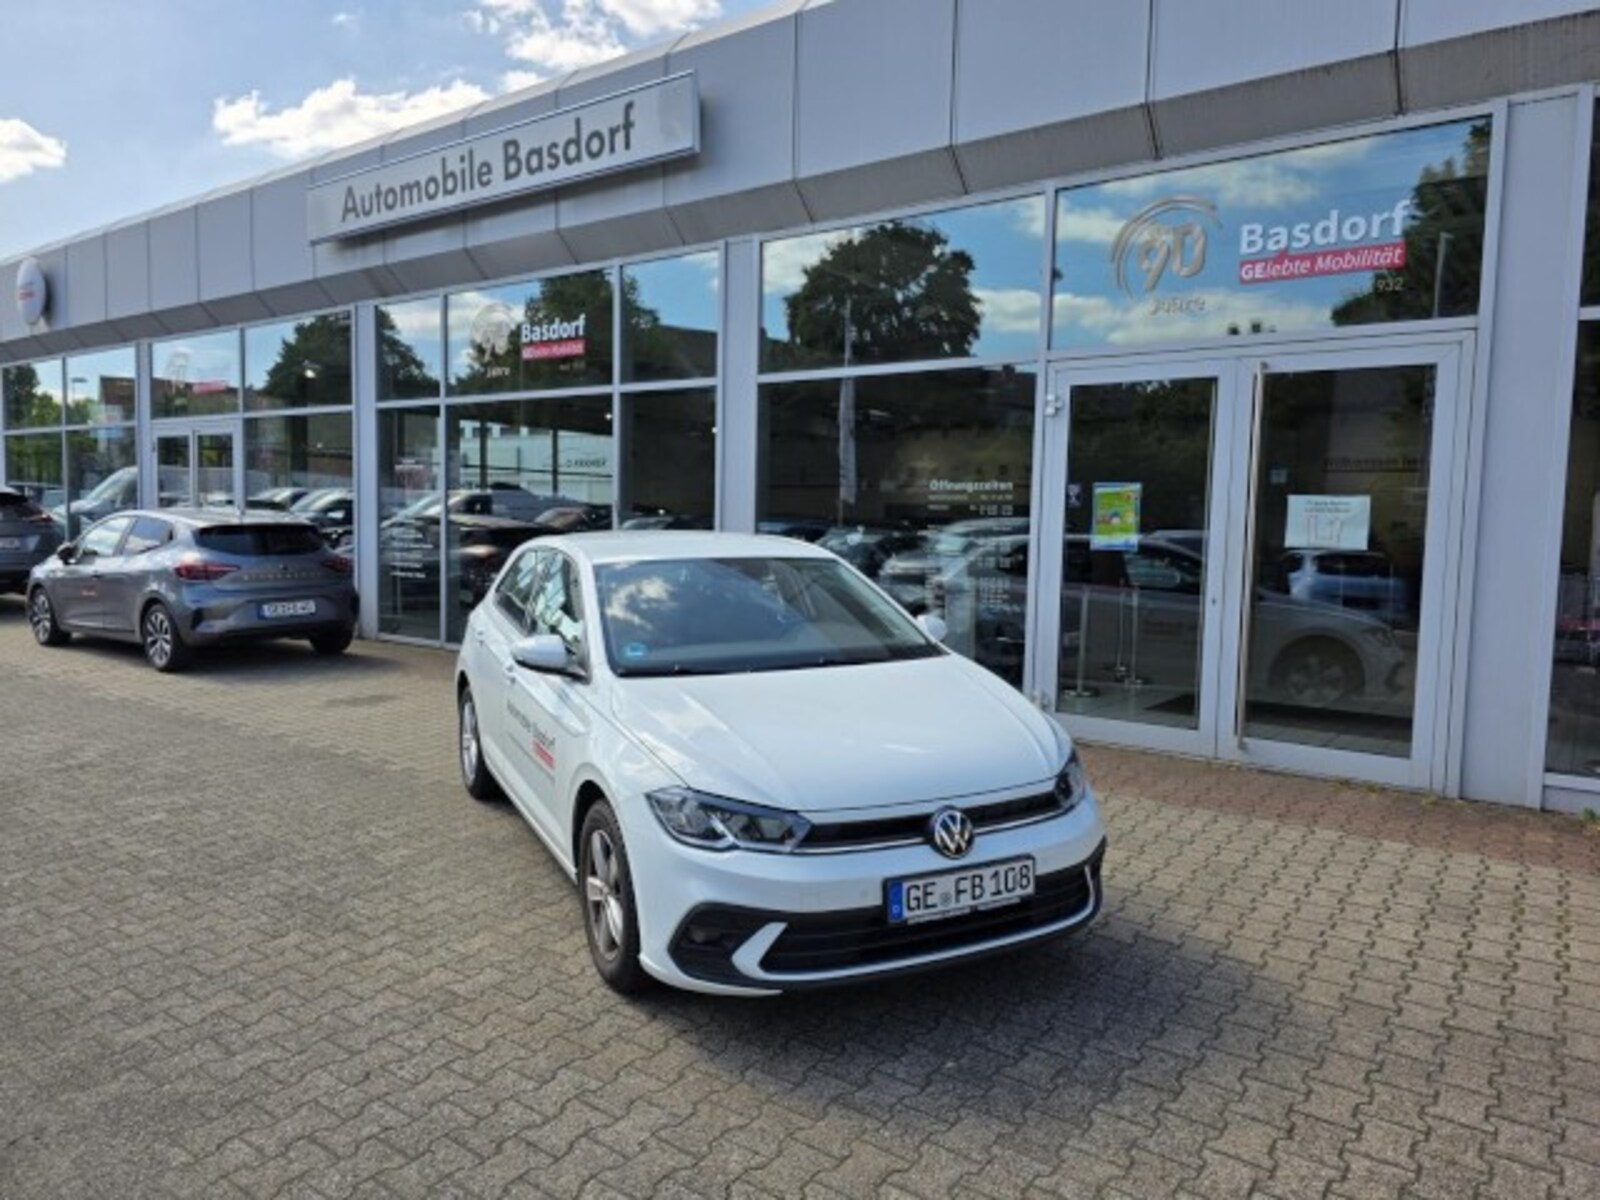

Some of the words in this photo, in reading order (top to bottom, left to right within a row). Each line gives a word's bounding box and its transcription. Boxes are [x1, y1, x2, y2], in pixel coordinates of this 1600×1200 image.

[340, 149, 494, 223] Automobile
[502, 101, 636, 182] Basdorf
[1239, 199, 1411, 255] Basdorf
[1240, 259, 1312, 281] GElebte
[1315, 247, 1402, 271] Mobilität
[521, 313, 587, 343] Basdorf
[905, 881, 938, 913] GE
[954, 874, 986, 903] FB
[990, 863, 1031, 897] 108
